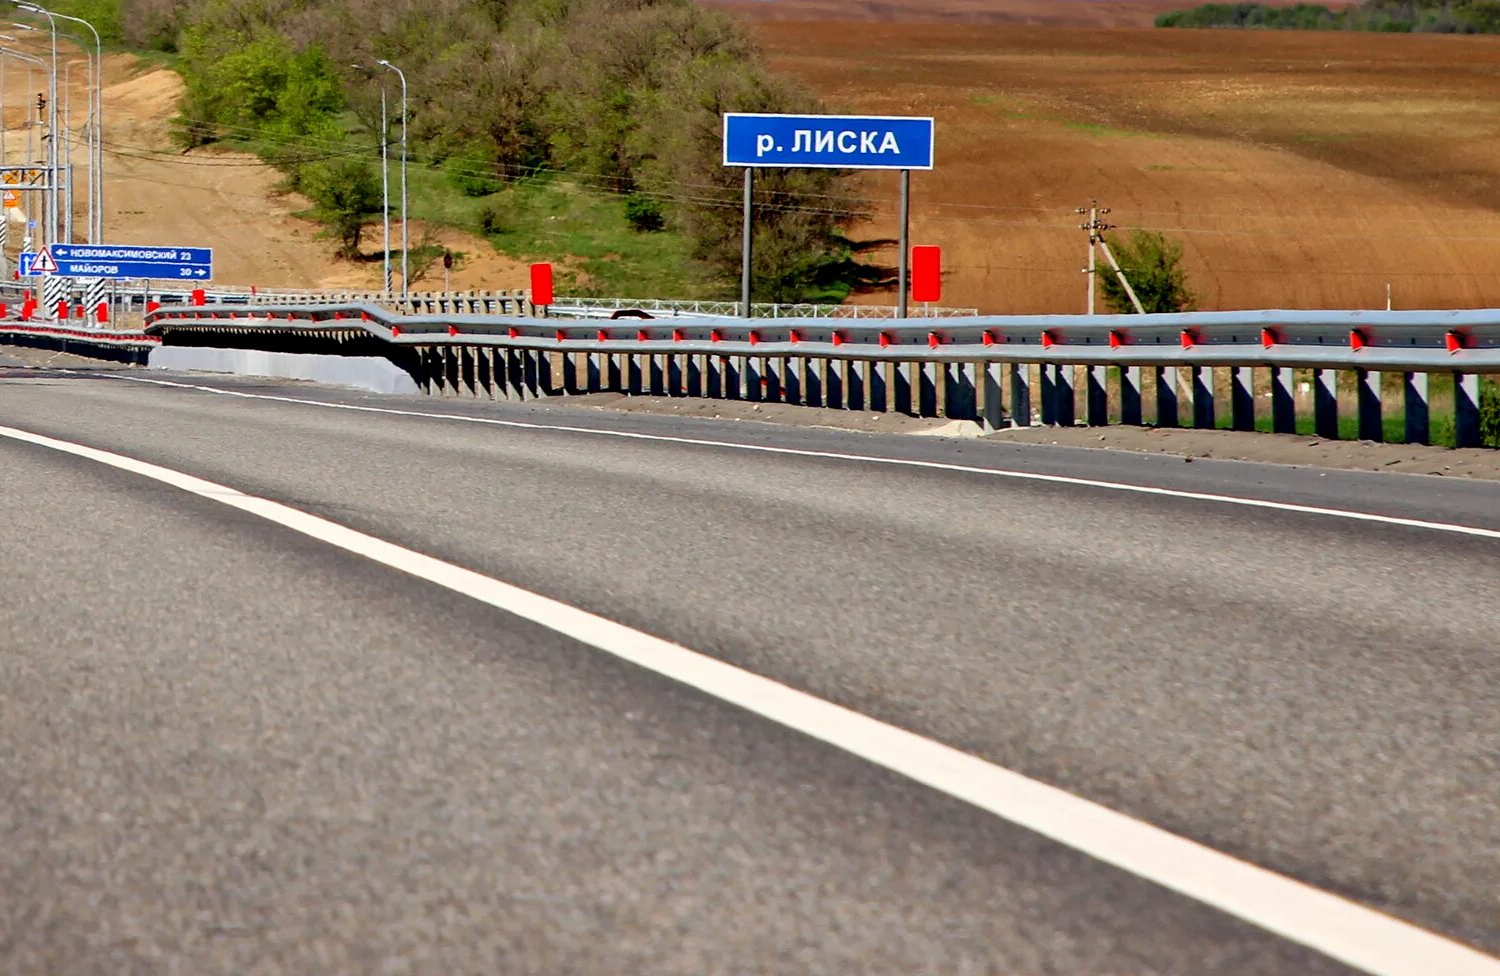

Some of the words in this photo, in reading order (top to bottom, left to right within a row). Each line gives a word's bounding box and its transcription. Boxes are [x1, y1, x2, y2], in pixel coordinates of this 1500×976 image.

[756, 133, 783, 157] р.
[791, 129, 901, 154] ЛИСКА
[70, 249, 177, 259] НОВОМАКСИМОВСКИЙ
[180, 252, 192, 261] 23
[70, 263, 118, 274] МАЙОРОВ
